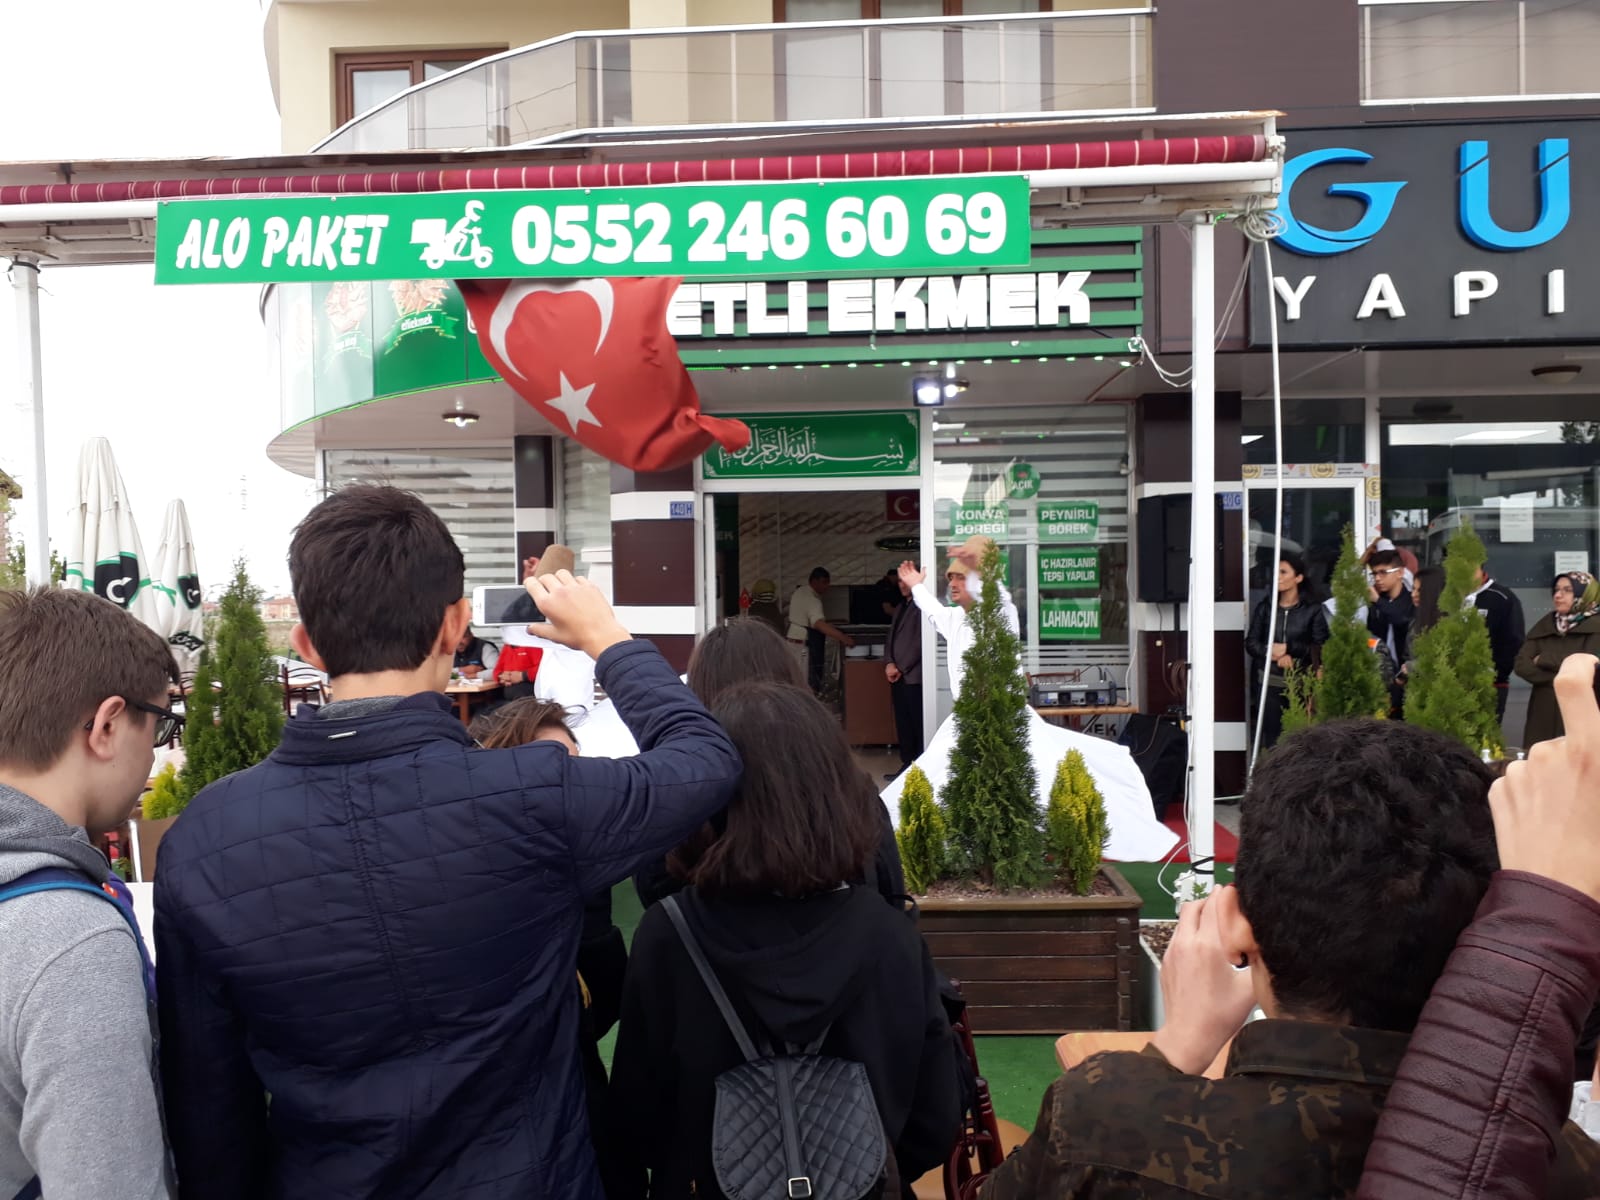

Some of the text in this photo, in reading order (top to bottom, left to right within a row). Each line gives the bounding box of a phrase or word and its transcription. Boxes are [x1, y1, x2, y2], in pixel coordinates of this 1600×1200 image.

[175, 191, 1007, 271] ALO PAKET 0552 246 60 69
[827, 271, 1092, 332] EKMEK
[1273, 269, 1565, 320] YAPI
[955, 509, 1005, 520] KONYA
[1041, 507, 1095, 520] PEYNİRLİ
[1042, 610, 1099, 628] LAHMACUN
